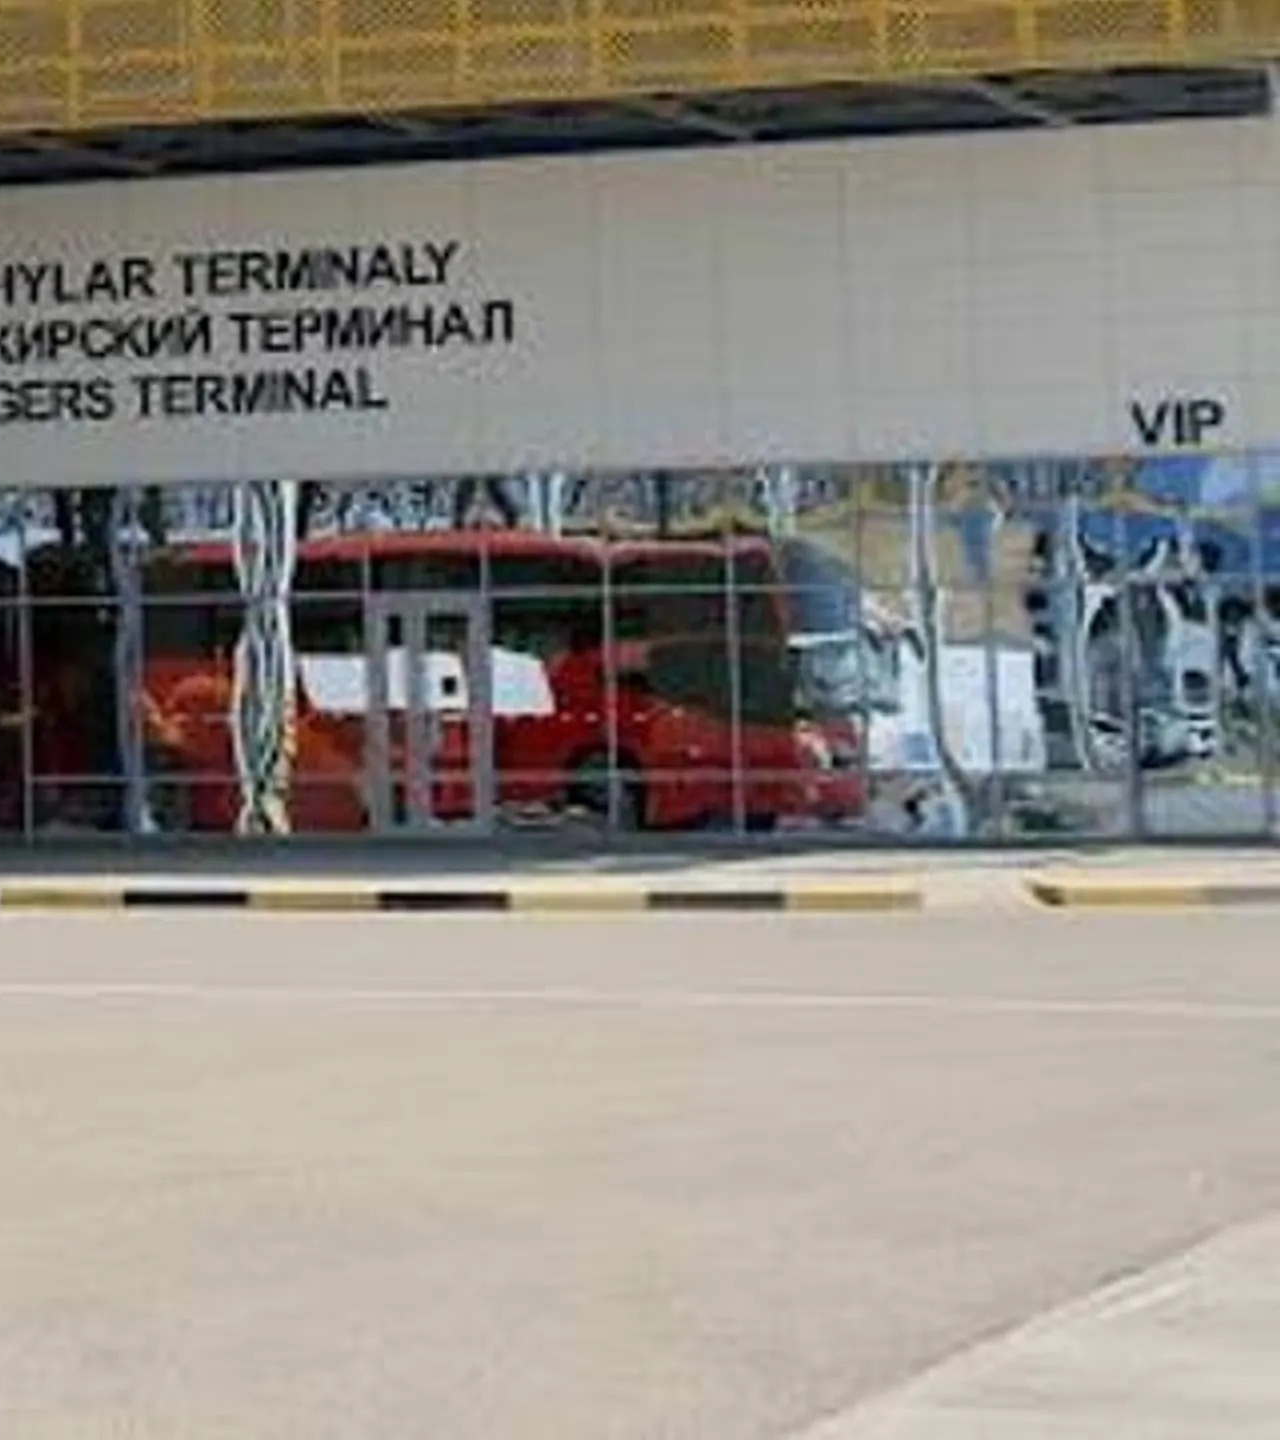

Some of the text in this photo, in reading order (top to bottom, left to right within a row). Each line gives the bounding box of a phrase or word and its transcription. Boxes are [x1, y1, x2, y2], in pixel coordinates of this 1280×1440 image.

[173, 241, 459, 298] TERMINALY
[226, 300, 514, 355] ТЕРМИНАЛ
[130, 366, 390, 418] TERMINAL
[1131, 399, 1225, 446] VIP
